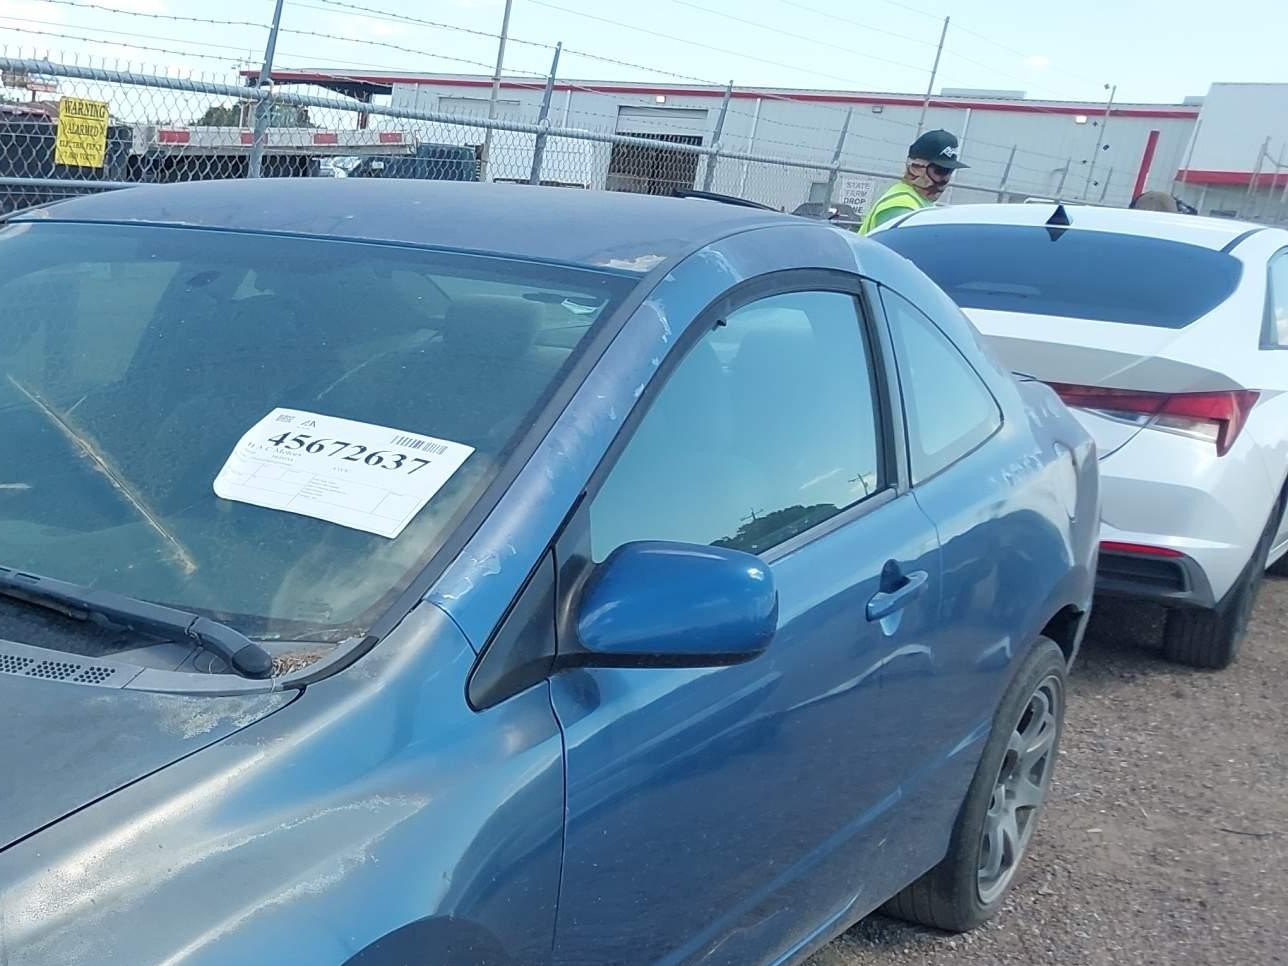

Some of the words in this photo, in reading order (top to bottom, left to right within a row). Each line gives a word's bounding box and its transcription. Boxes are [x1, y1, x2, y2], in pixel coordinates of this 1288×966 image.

[64, 100, 106, 119] WARNING
[843, 197, 867, 205] DROP
[267, 431, 433, 475] 45672637
